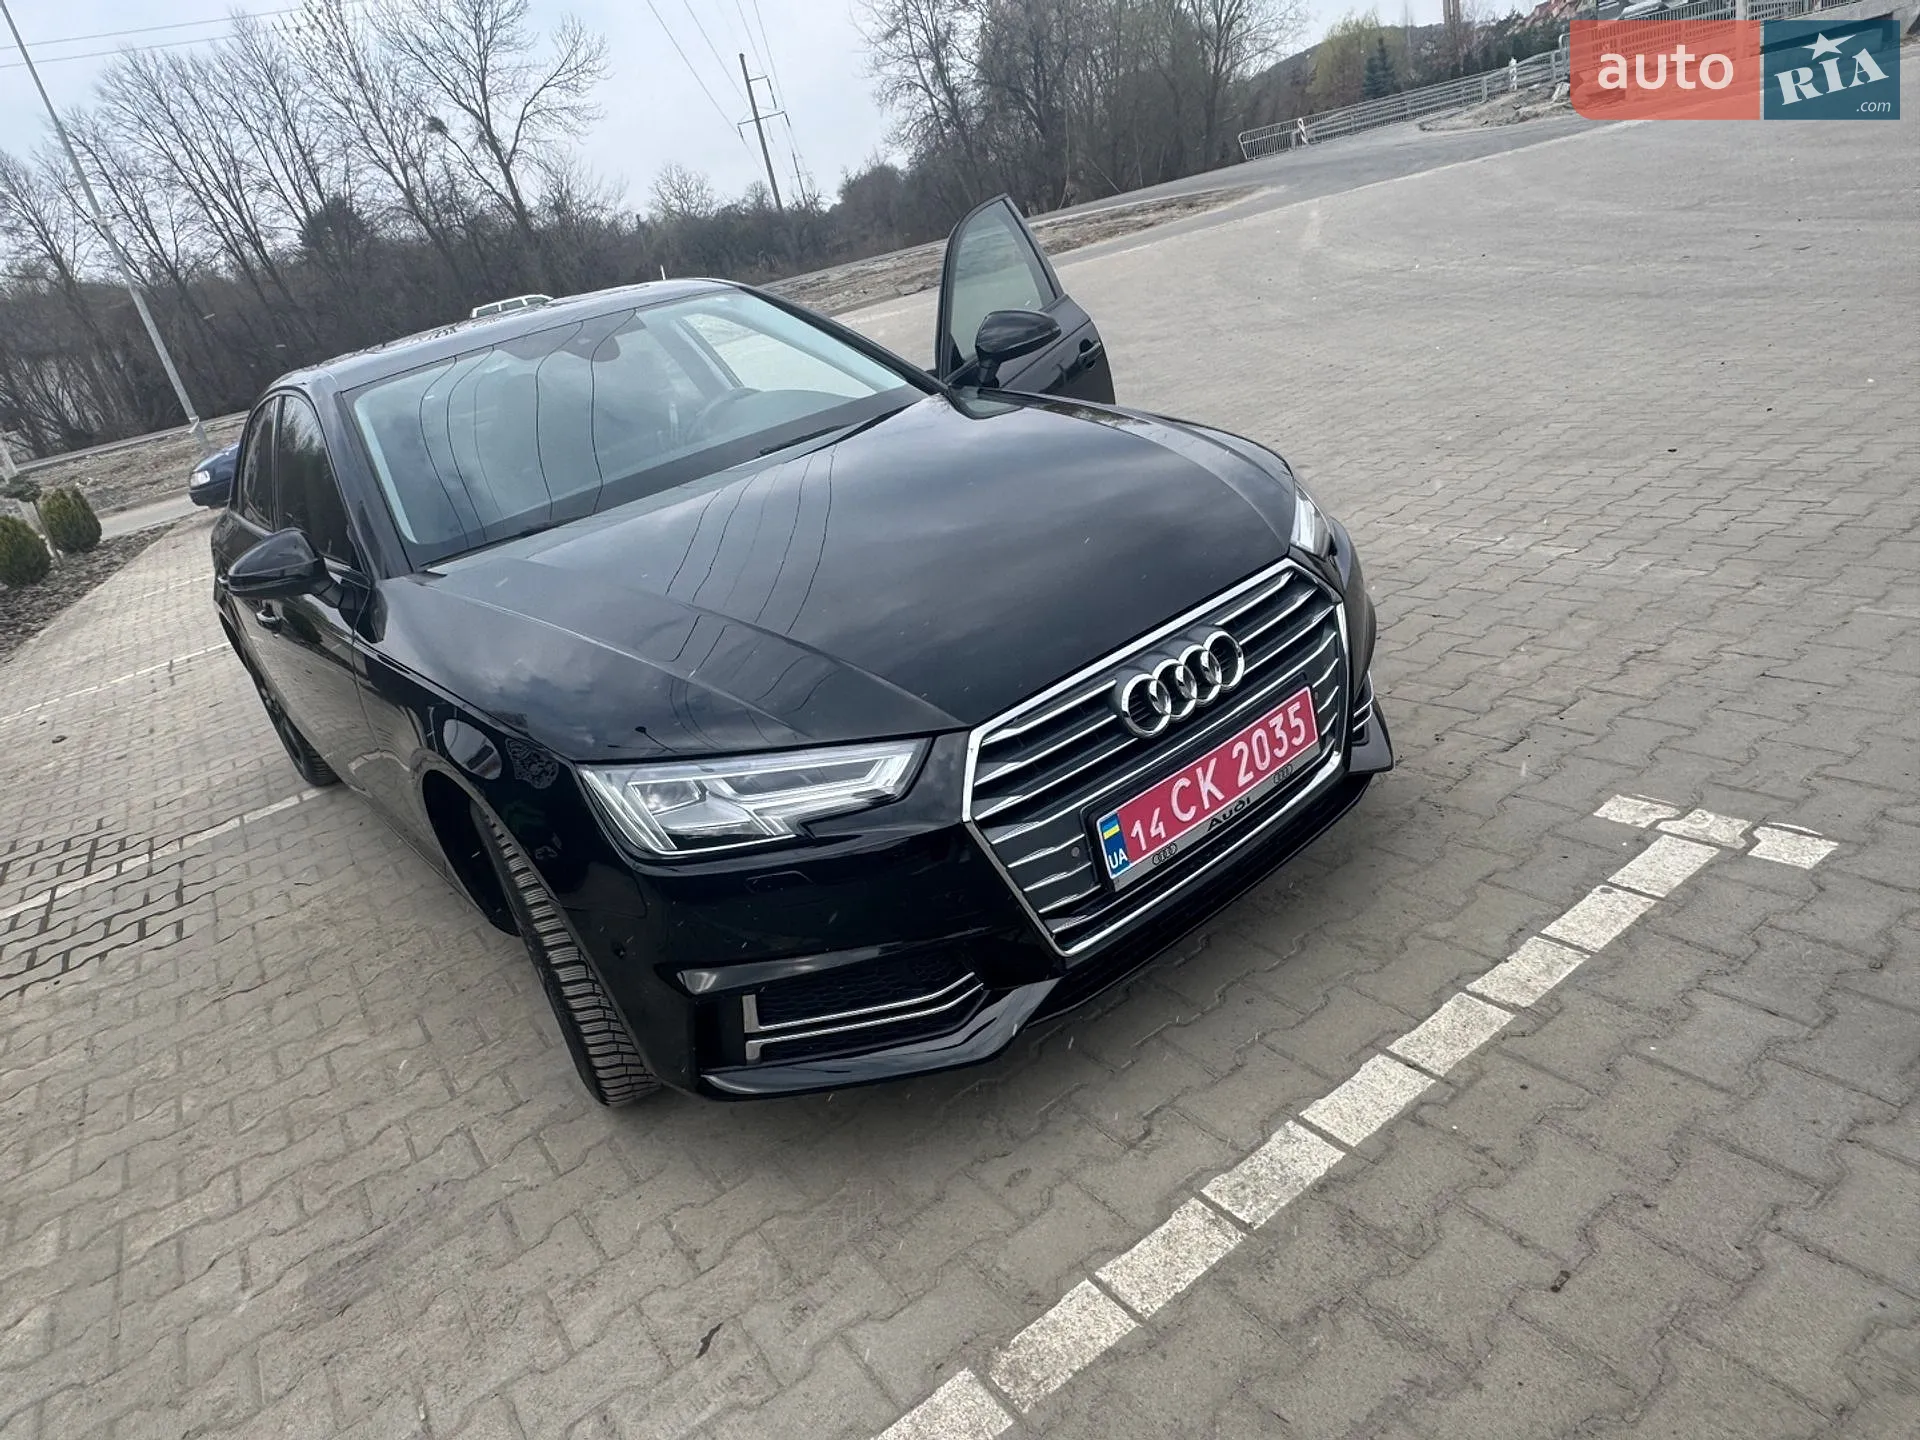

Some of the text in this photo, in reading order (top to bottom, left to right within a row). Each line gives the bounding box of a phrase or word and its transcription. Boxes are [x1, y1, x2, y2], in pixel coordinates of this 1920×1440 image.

[1130, 702, 1306, 851] 14 CK 2035
[1108, 848, 1128, 869] UA
